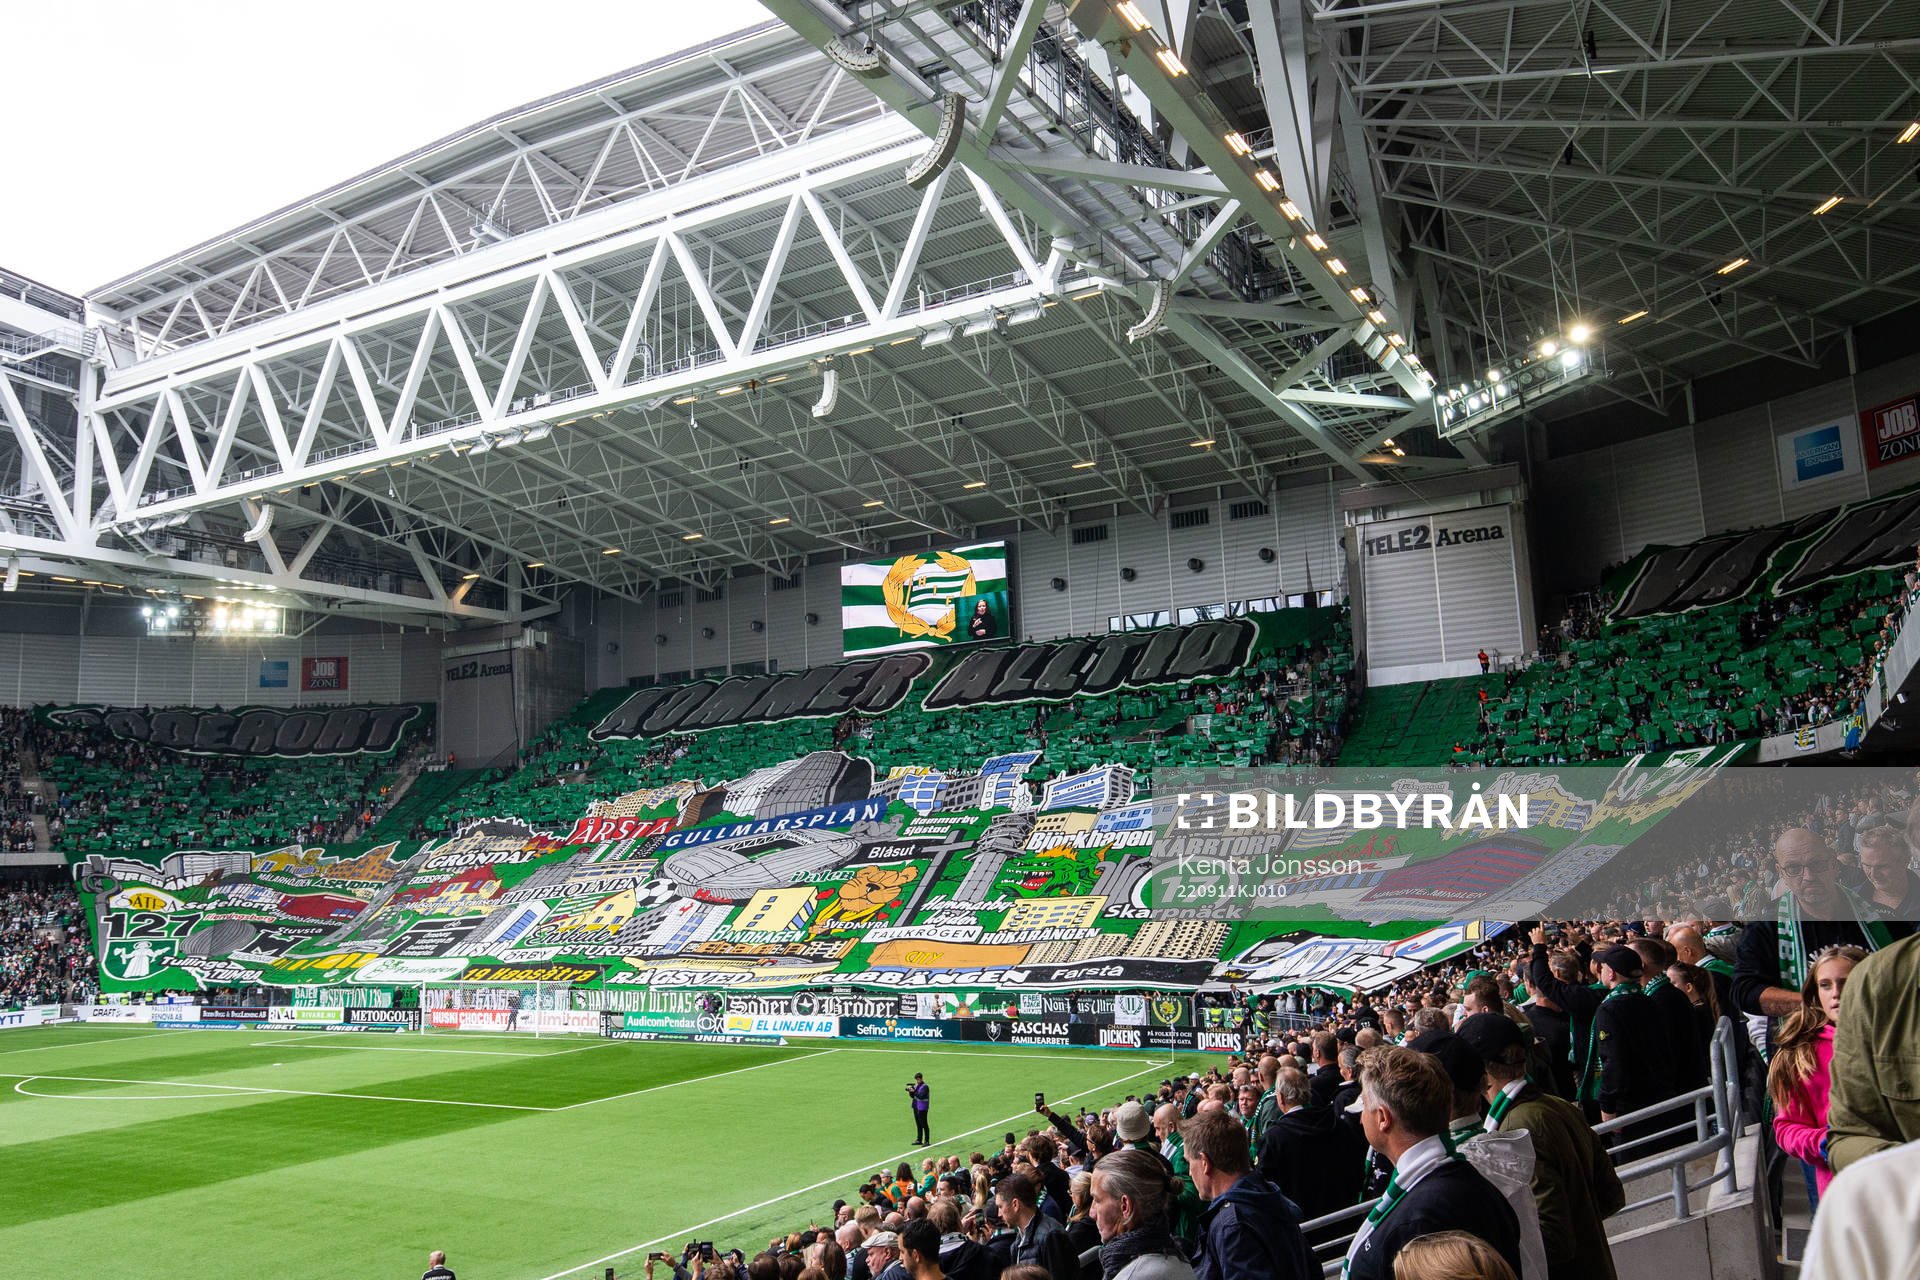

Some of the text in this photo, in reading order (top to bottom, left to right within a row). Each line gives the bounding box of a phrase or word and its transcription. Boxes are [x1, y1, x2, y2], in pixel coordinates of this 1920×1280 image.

[1879, 404, 1917, 439] JOB
[1366, 525, 1504, 557] TELE2 Arena
[312, 660, 335, 677] JOB
[447, 661, 512, 682] TELE2 Arena
[310, 678, 339, 688] ZONE
[595, 655, 923, 735] KOMMER
[666, 803, 879, 848] GULLMARSPLAN
[910, 815, 979, 826] Hammarby
[568, 818, 668, 845] ÅRSTA
[903, 825, 951, 836] sjöstad
[1027, 830, 1157, 851] Björkhagen
[1151, 833, 1282, 858] KÄRRTORP
[427, 849, 534, 869] GRÖNDAL
[868, 844, 915, 859] Blåsut
[313, 879, 388, 891] ASPUDDEN
[501, 875, 648, 902] LILJEHOLMEN
[1160, 875, 1222, 903] 17
[116, 893, 178, 912] SÄTRA
[203, 912, 276, 923] Flemingsberg
[924, 911, 978, 926] höjden
[1104, 904, 1243, 920] Skarpnäck
[103, 912, 204, 939] 127
[277, 926, 324, 935] Stuvsta
[824, 919, 890, 930] SVEDMYRA
[525, 925, 613, 947] Enskede
[872, 928, 976, 942] TALLKROGEN
[980, 926, 1100, 944] HÖKARÄNGEN
[503, 950, 551, 962] ÖRBY
[558, 943, 667, 957] STUREBY
[906, 951, 943, 965] CITY
[161, 957, 230, 970] Tullinge
[207, 969, 263, 981] TUMBA
[464, 966, 597, 982] 19 Hagsätra
[609, 967, 754, 986] RÅGSVED
[811, 967, 1030, 986] GUBBÄNGEN
[1052, 964, 1124, 980] Farsta
[588, 990, 692, 1013] HAMMARBY ULTRAS
[93, 1008, 116, 1017] CRAFT
[432, 1012, 458, 1024] HUSKI
[627, 1015, 696, 1029] AudicomPendax
[756, 1020, 833, 1032] EL LINJEN AB
[1011, 1022, 1069, 1035] SASCHAS
[612, 1032, 658, 1040] UNIBET
[695, 1034, 744, 1043] UNIBET
[857, 1023, 943, 1039] Sefina pantbank
[1100, 1029, 1141, 1048] DICKENS
[1011, 1035, 1070, 1046] FAMILJEARBETE
[1198, 1032, 1242, 1052] DICKENS
